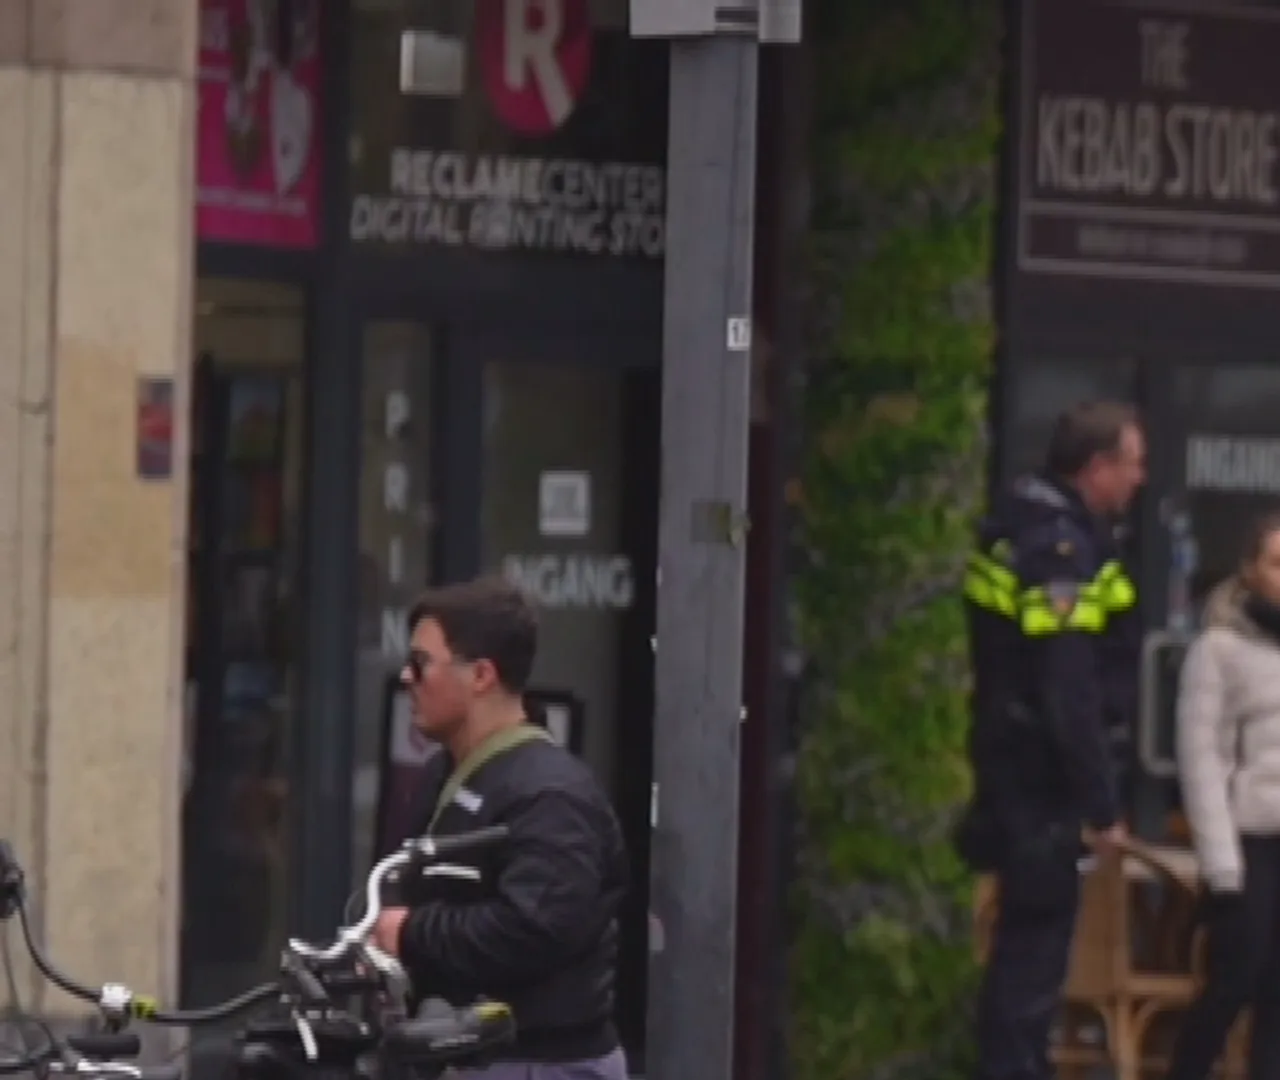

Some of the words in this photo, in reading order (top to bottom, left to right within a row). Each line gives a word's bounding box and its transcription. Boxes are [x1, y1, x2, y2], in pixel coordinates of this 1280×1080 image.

[1138, 20, 1189, 89] THE
[1037, 96, 1157, 196] KEBAB
[1164, 104, 1278, 205] STORE
[350, 194, 464, 244] DIGITAL
